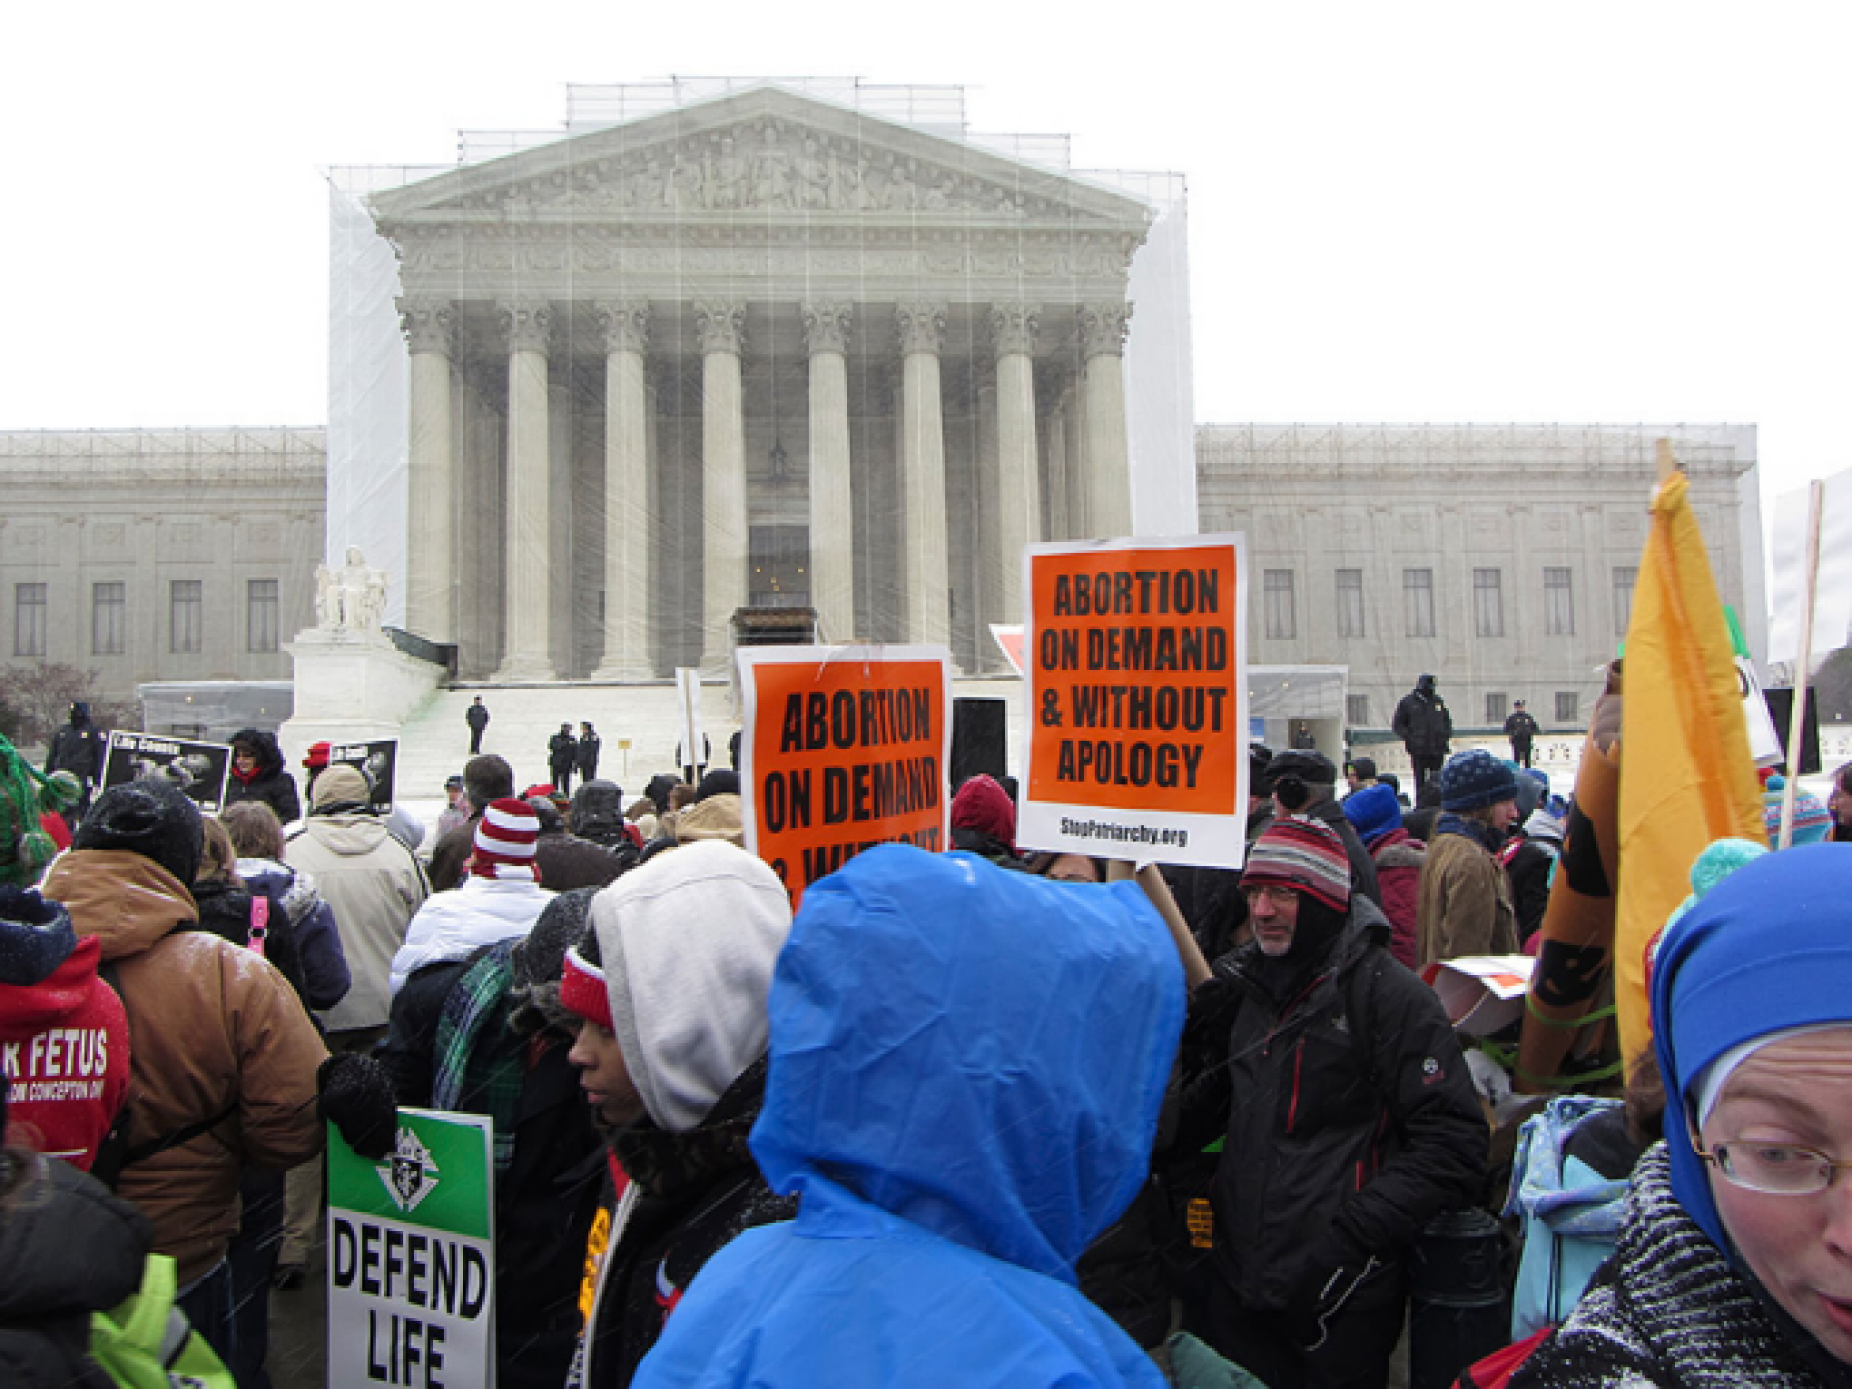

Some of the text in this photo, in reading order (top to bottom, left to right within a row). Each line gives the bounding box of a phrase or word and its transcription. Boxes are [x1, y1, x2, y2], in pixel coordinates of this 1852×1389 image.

[1054, 569, 1219, 616] ABORTION
[1040, 627, 1227, 671] ON DEMAND
[780, 688, 930, 752] ABORTION
[1041, 685, 1227, 732] & WITHOUT
[1057, 740, 1204, 788] APOLOGY
[764, 757, 938, 833] ON DEMAND
[1060, 816, 1188, 847] StopPatriarchy.org
[29, 1027, 108, 1077] FETUS
[332, 1217, 487, 1320] DEFEND
[367, 1309, 445, 1389] LIFE
